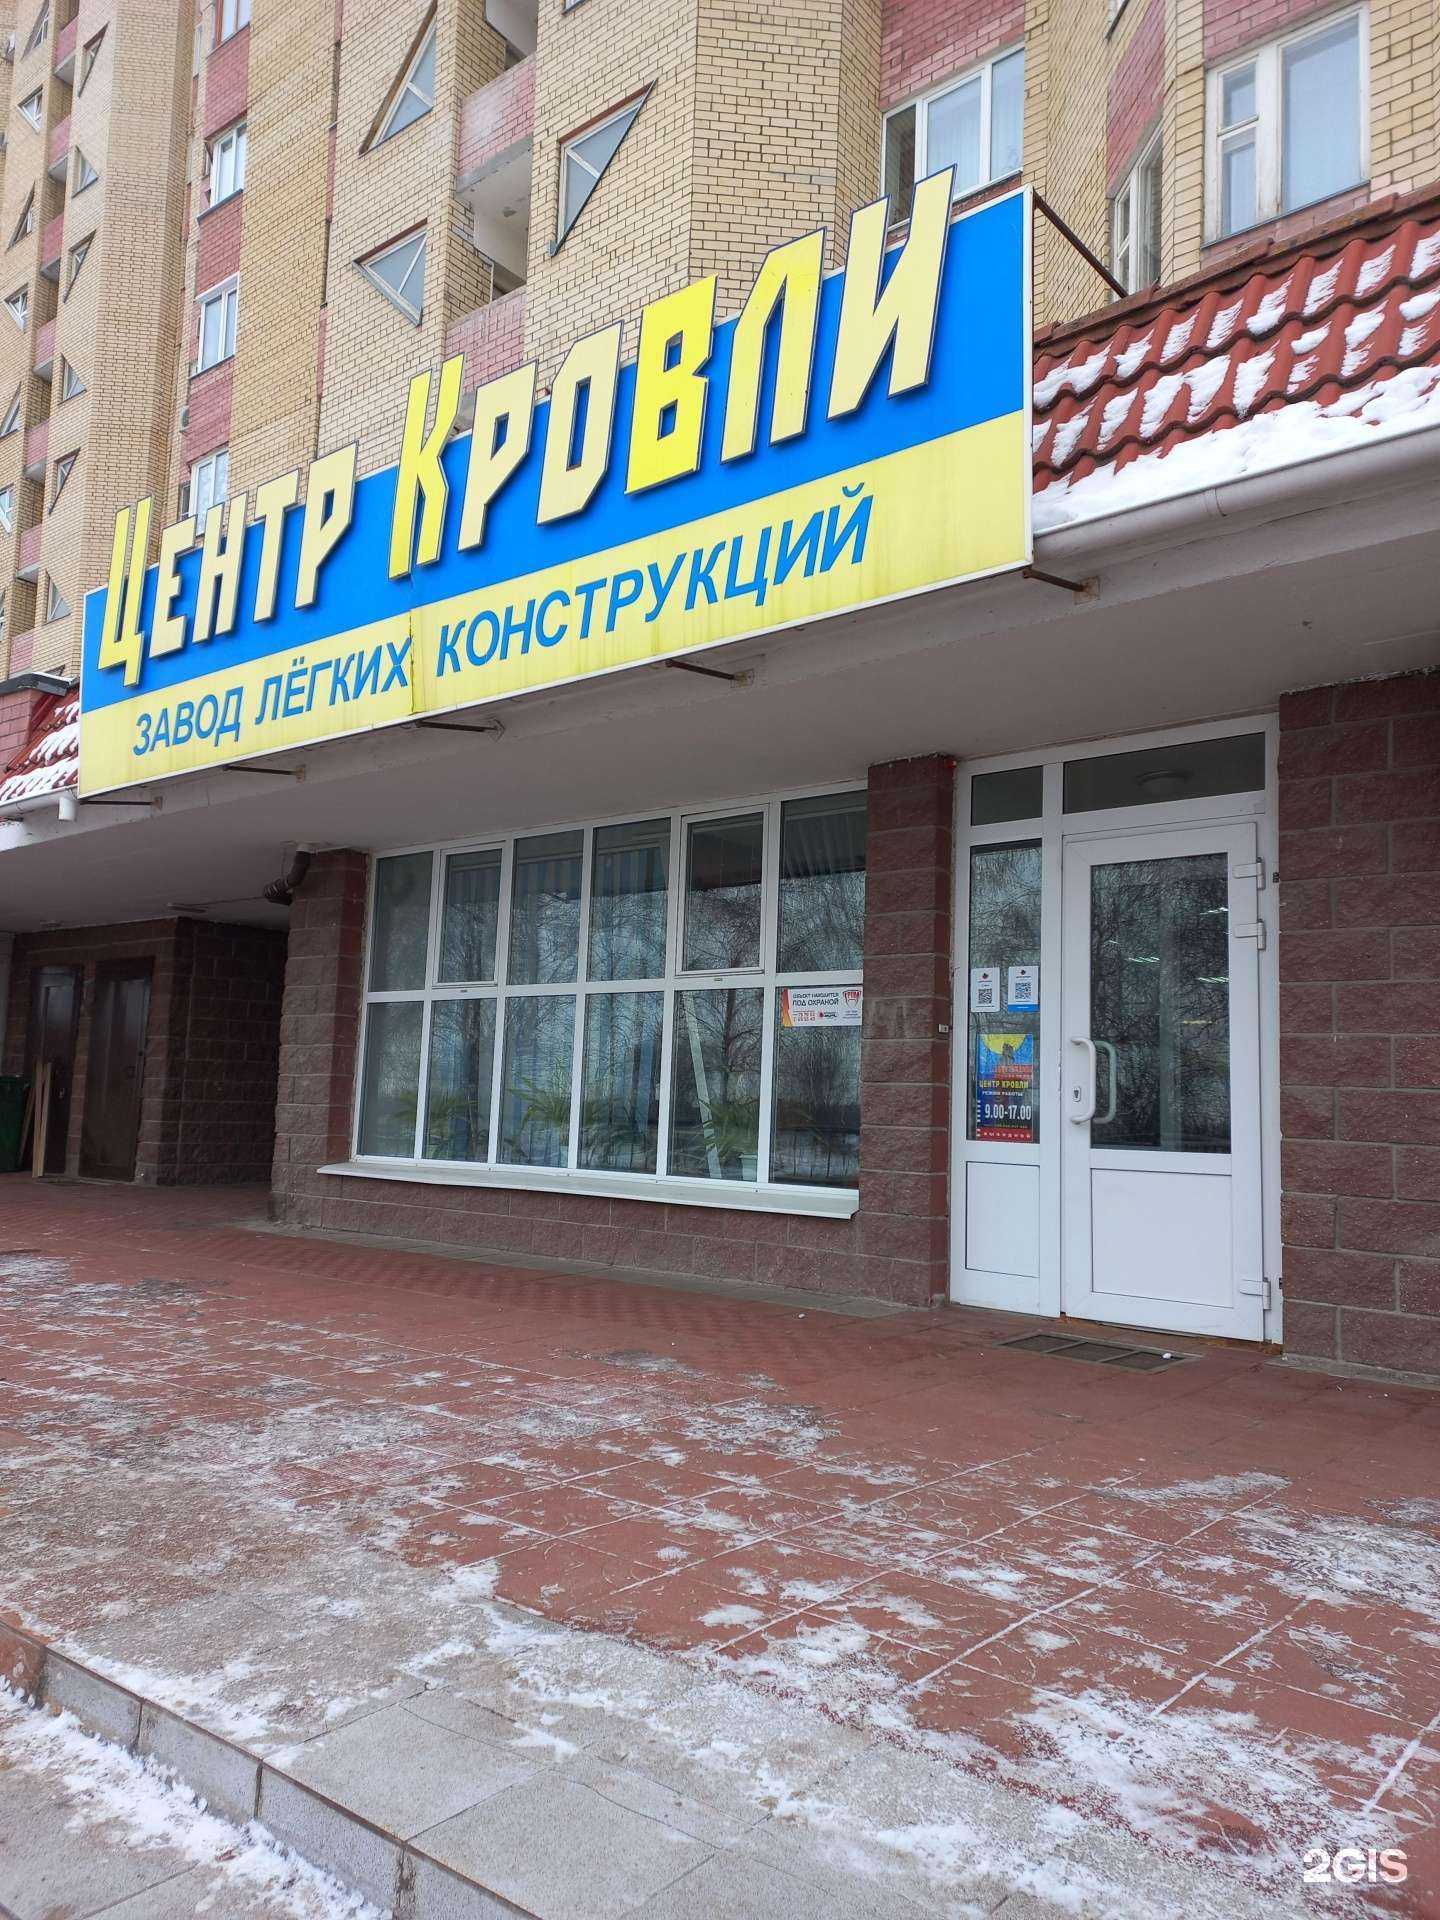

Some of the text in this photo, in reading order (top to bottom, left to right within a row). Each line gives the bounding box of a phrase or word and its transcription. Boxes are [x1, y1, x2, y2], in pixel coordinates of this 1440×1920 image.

[133, 482, 874, 756] ЗАВОД ЛЁГКИХ КОНСТРУКЦИЙ
[808, 998, 839, 1006] ОХРАНОЙ
[979, 1080, 1029, 1088] ЦЕНТР КРОВЛИ
[984, 1104, 1032, 1120] 9.00-17.00
